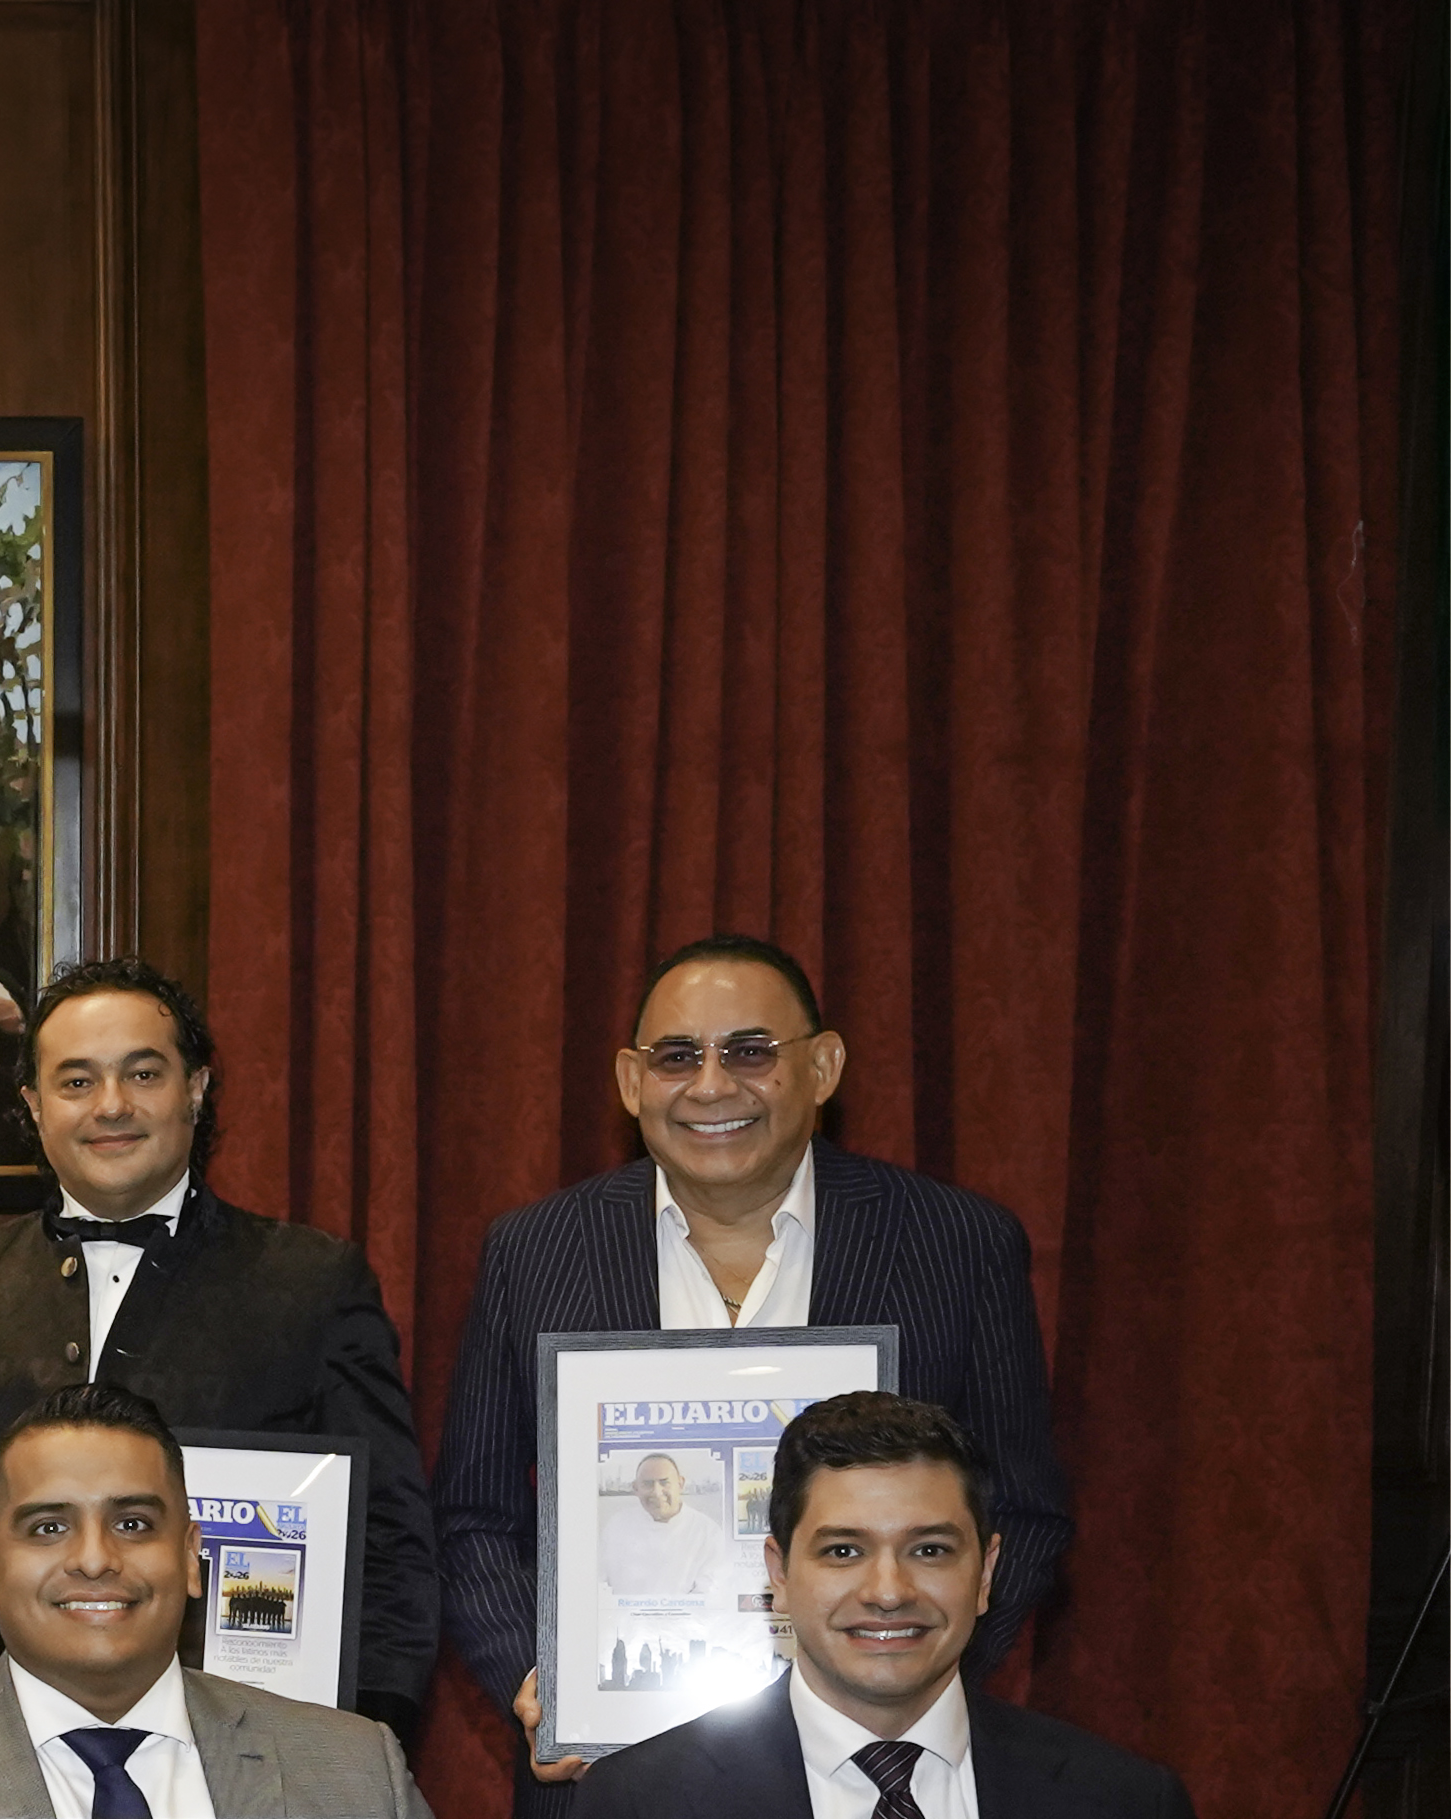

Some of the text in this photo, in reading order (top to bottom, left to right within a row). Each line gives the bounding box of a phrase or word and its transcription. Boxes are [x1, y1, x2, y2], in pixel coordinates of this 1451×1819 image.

[604, 1400, 768, 1425] EL DIARIO
[188, 1499, 255, 1524] ARIO
